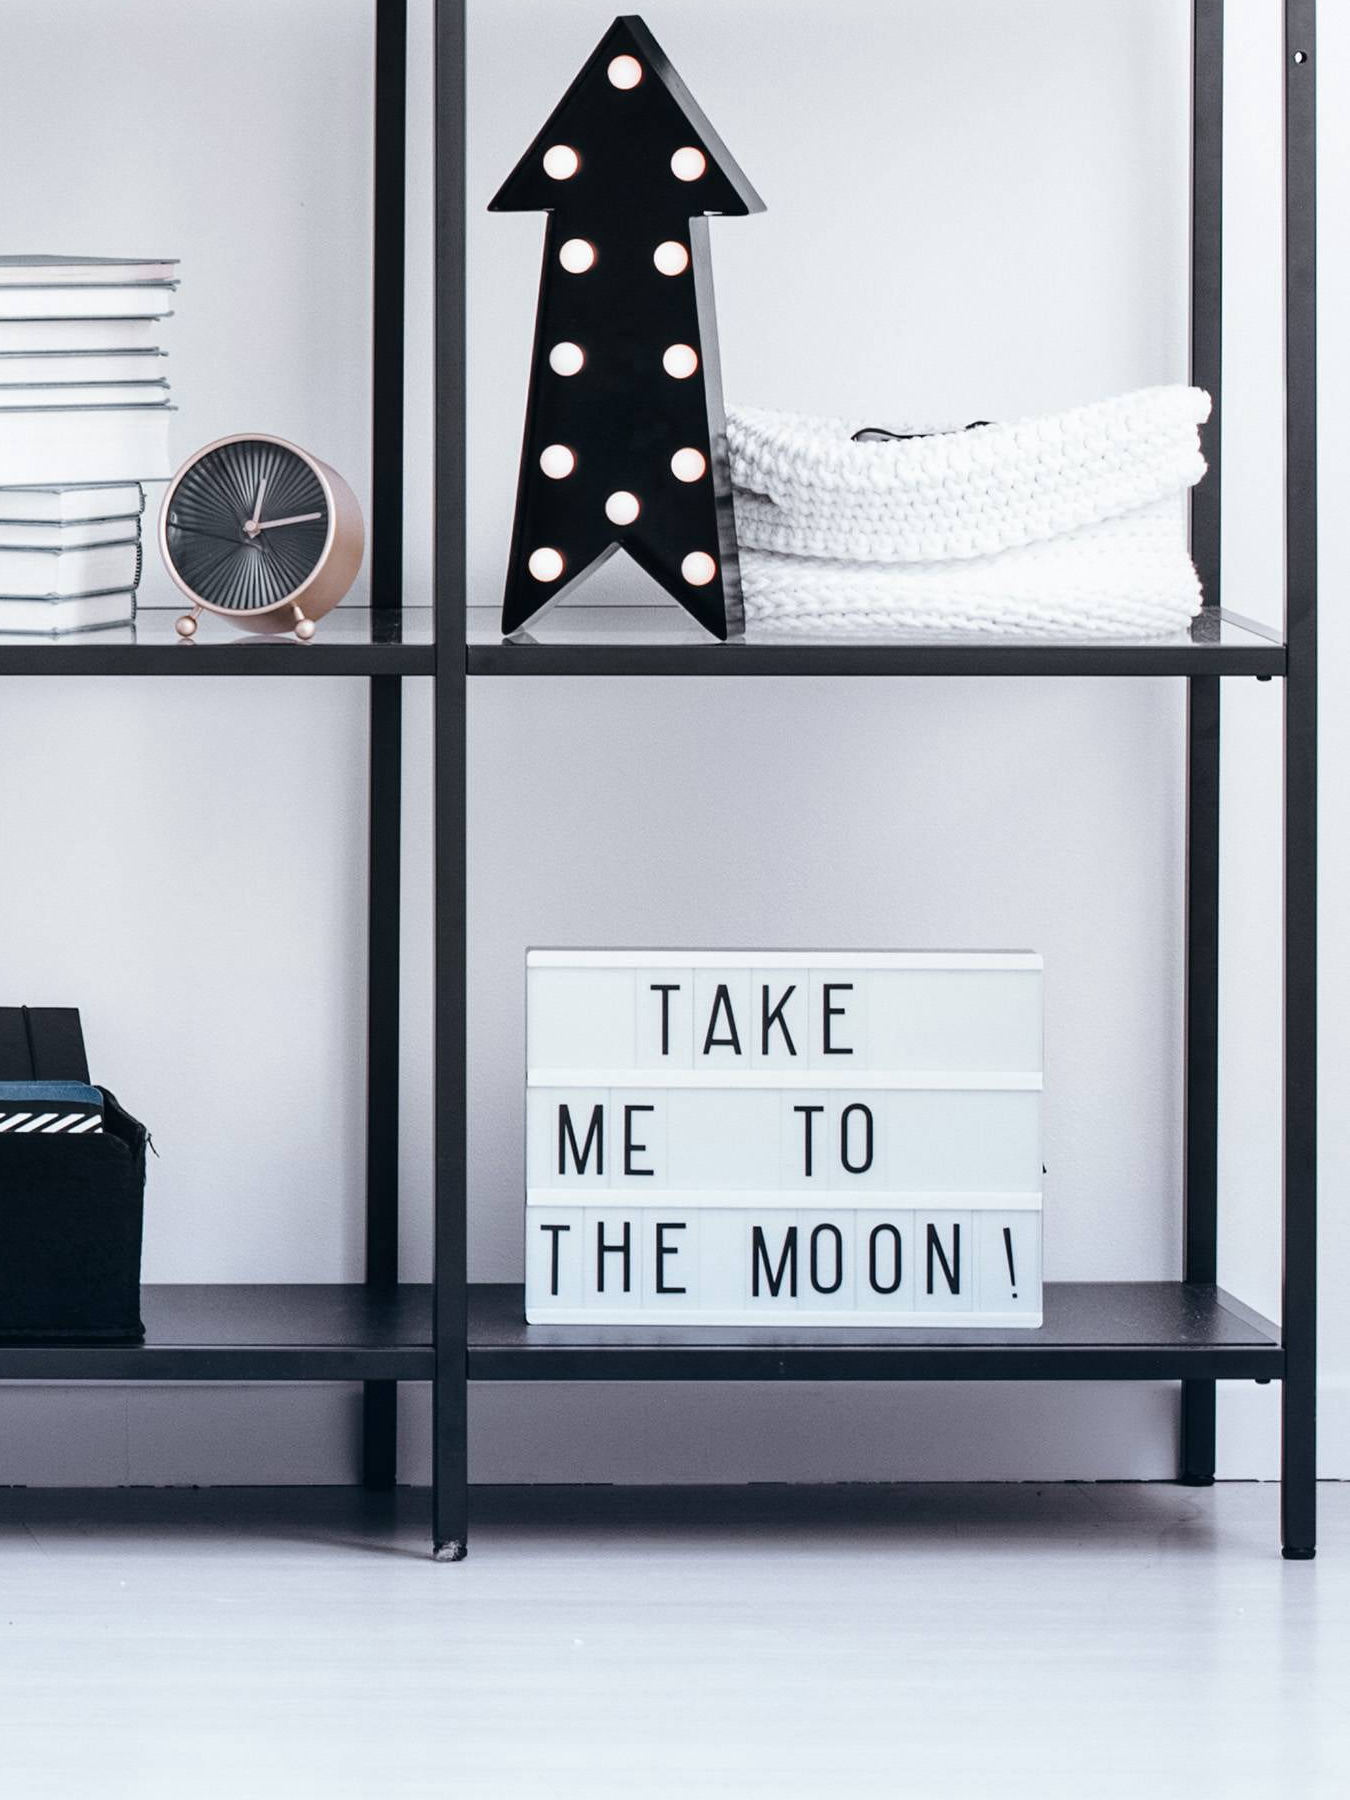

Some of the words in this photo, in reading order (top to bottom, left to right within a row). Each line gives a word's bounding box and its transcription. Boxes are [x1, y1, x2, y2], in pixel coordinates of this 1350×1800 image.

[650, 983, 854, 1057] TAKE
[558, 1103, 655, 1177] ME
[793, 1102, 874, 1177] TO
[540, 1221, 687, 1296] THE
